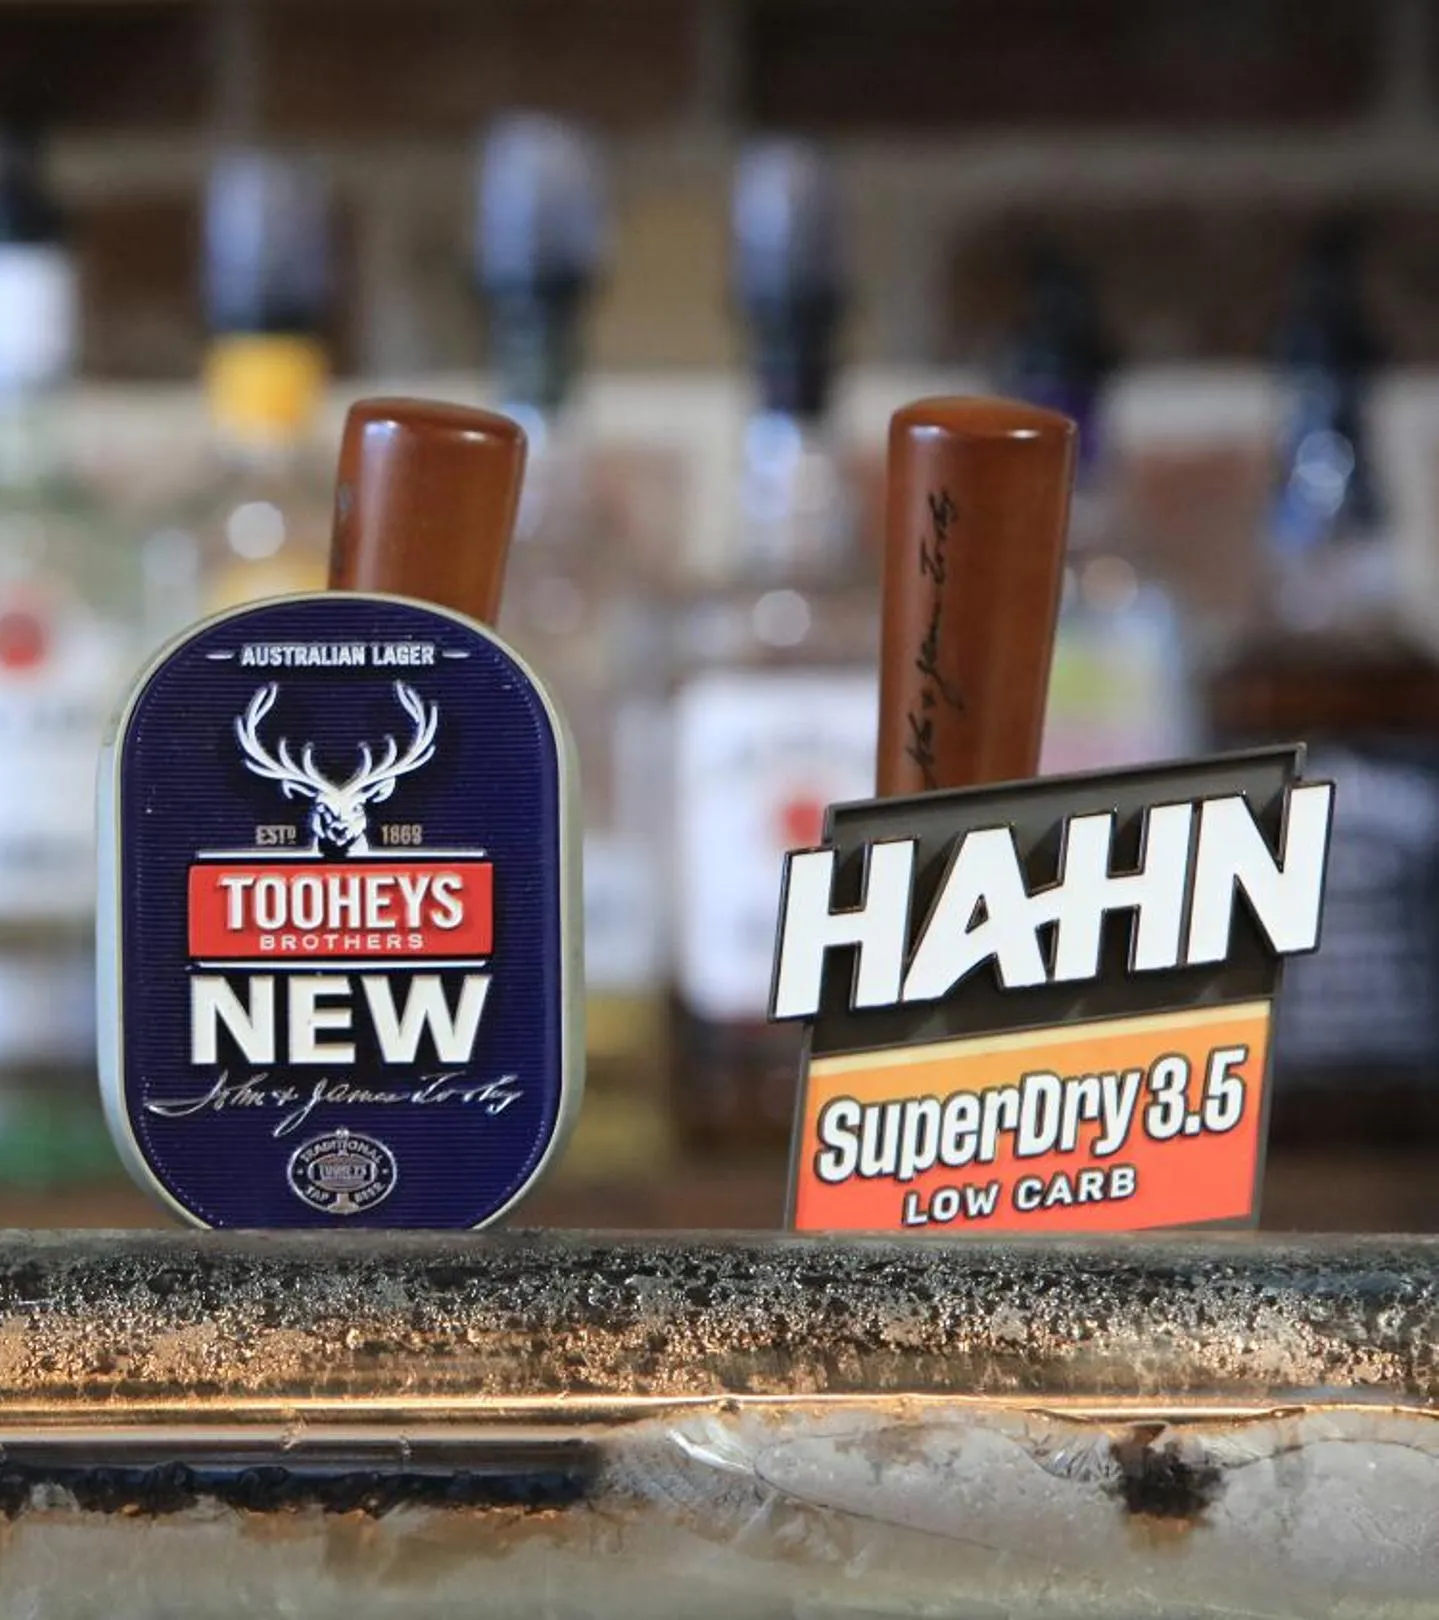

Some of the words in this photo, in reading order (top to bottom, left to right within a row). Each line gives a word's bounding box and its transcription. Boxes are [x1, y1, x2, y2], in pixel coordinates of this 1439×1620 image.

[241, 645, 366, 667] AUSTRALIAN
[371, 645, 435, 666] LAGER
[220, 874, 464, 931] TOOHEYS
[770, 781, 1335, 1022] HAHN
[260, 934, 424, 950] BROTHERS
[190, 976, 492, 1065] NEW
[816, 1069, 1142, 1183] SuperDry
[1145, 1044, 1249, 1140] 3.5
[903, 1185, 999, 1225] LOW
[1016, 1168, 1137, 1212] CARB
